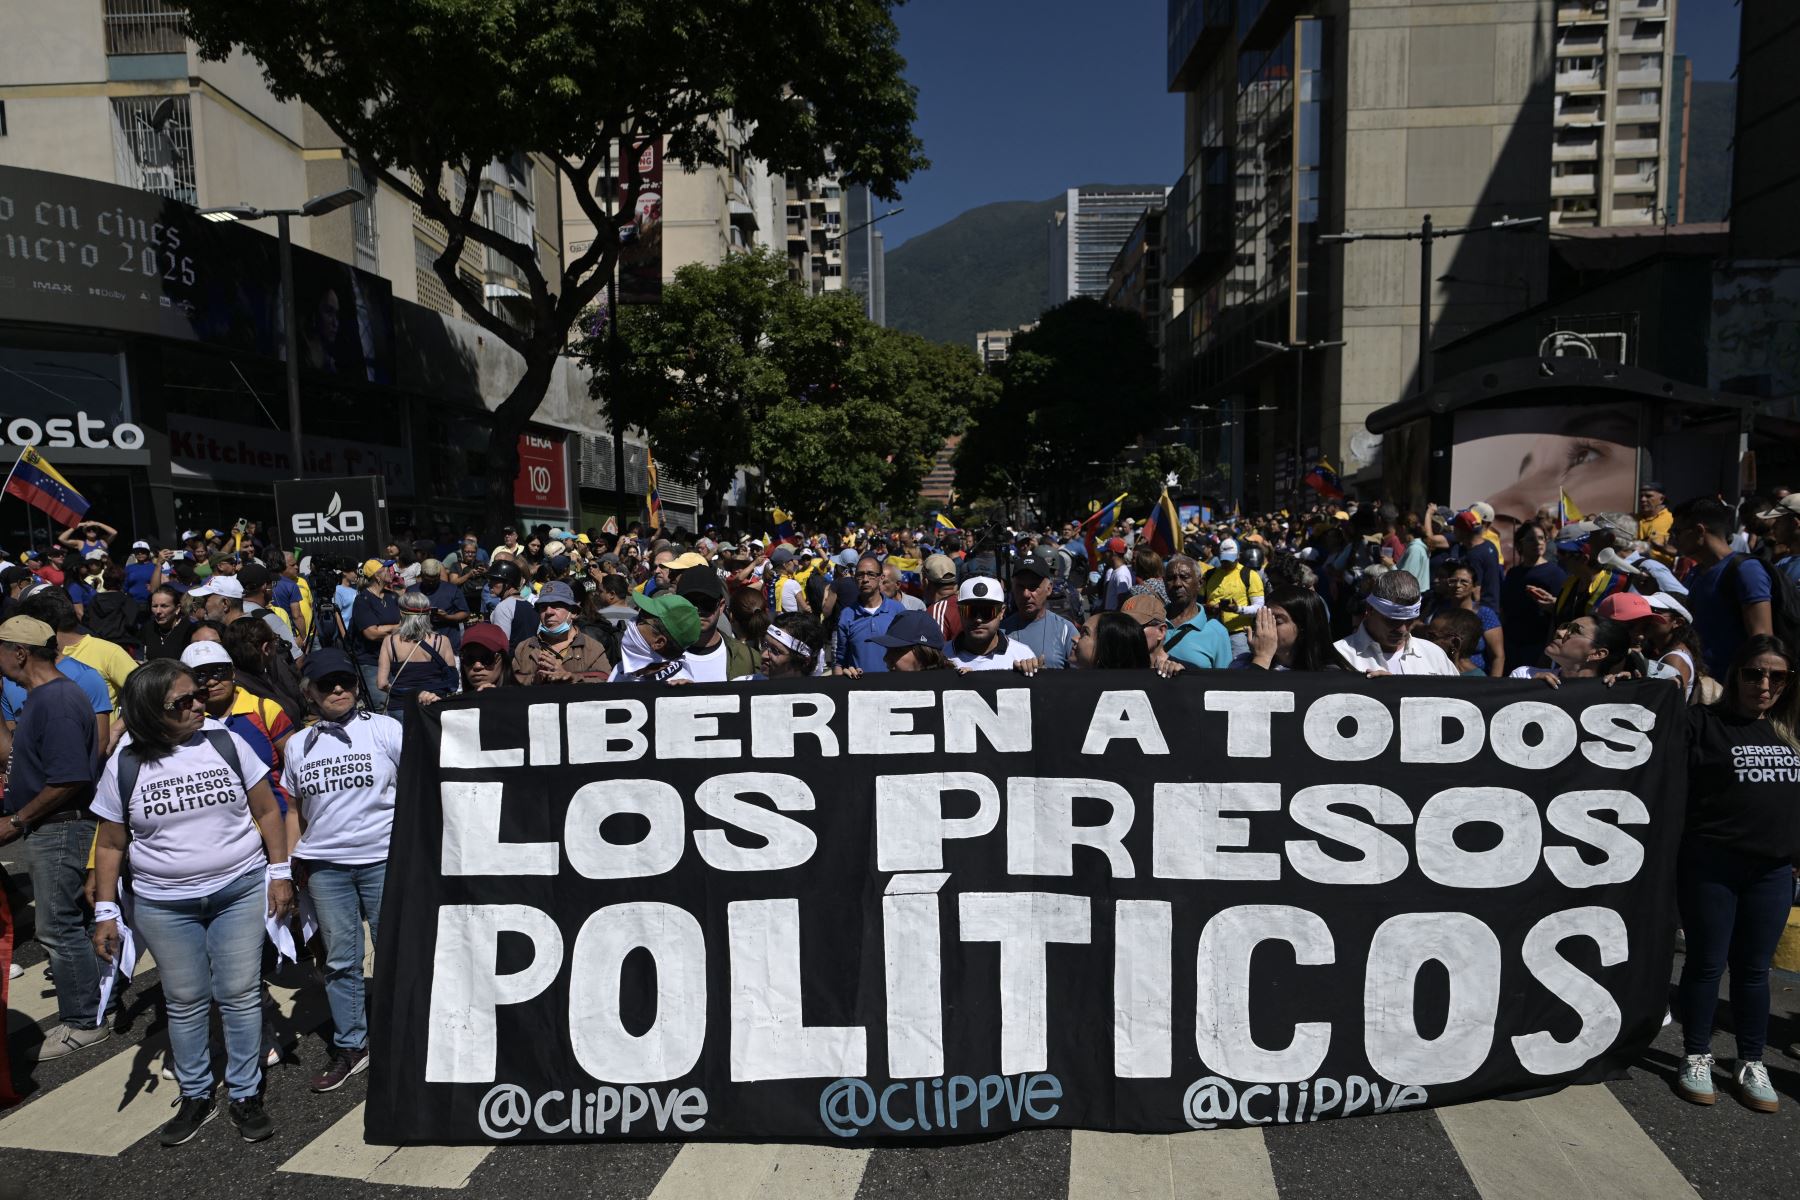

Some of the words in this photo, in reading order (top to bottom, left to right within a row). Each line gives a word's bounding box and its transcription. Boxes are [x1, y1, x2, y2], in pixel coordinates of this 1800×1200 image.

[35, 201, 79, 230] en
[98, 208, 181, 249] cines
[33, 280, 72, 293] IMAX
[101, 288, 126, 301] Dolby
[0, 411, 144, 450] osto
[529, 465, 551, 493] 100
[292, 510, 364, 534] EKO
[295, 533, 364, 543] ILUMINACIÓN
[440, 688, 1032, 769] LIBEREN
[1081, 690, 1170, 755] A
[1204, 690, 1656, 770] TODOS
[300, 758, 333, 773] LIBEREN
[335, 755, 342, 763] A
[343, 753, 372, 762] TODOS
[1731, 745, 1792, 756] CIERREN
[1733, 755, 1800, 768] CENTROS
[140, 776, 185, 793] LIBEREN
[187, 774, 195, 782] A
[197, 767, 229, 781] TODOS
[300, 771, 320, 785] LOS
[323, 762, 373, 778] PRESOS
[301, 773, 375, 799] POLÍTICOS
[1734, 768, 1800, 782] TORTU
[143, 788, 171, 803] LOS
[175, 776, 232, 799] PRESOS
[144, 788, 237, 819] POLÍTICOS
[441, 772, 817, 880] LOS
[876, 772, 1650, 888] PRESOS
[425, 872, 1628, 1085] POLÍTICOS
